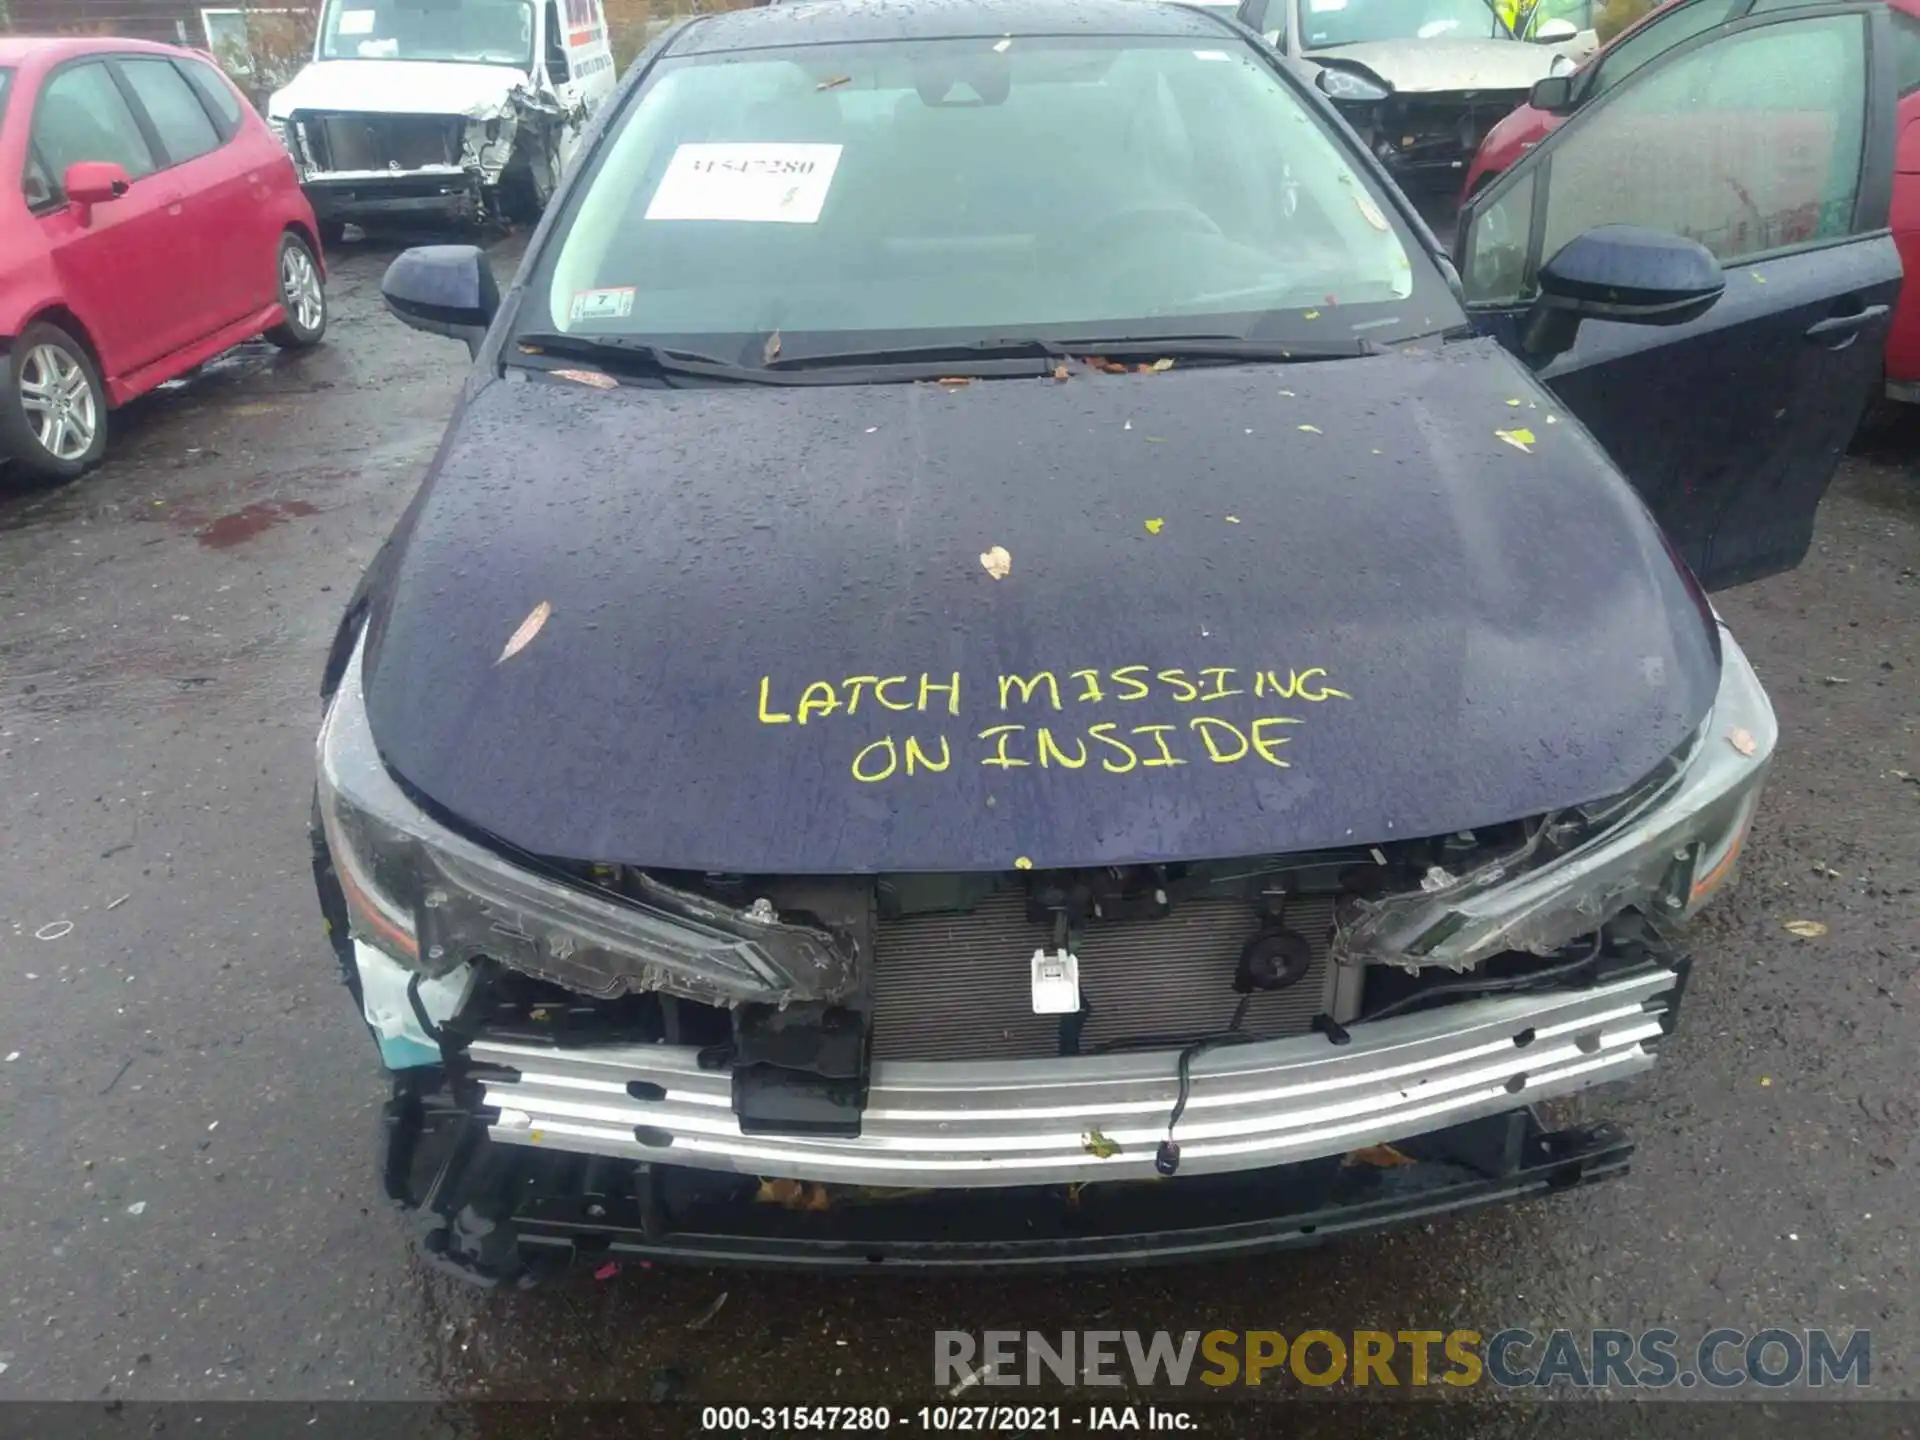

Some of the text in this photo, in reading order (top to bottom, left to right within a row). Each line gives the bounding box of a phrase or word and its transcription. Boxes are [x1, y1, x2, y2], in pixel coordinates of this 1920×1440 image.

[758, 666, 1353, 724] LATCH MISSING
[851, 717, 1305, 782] ON INSIDE
